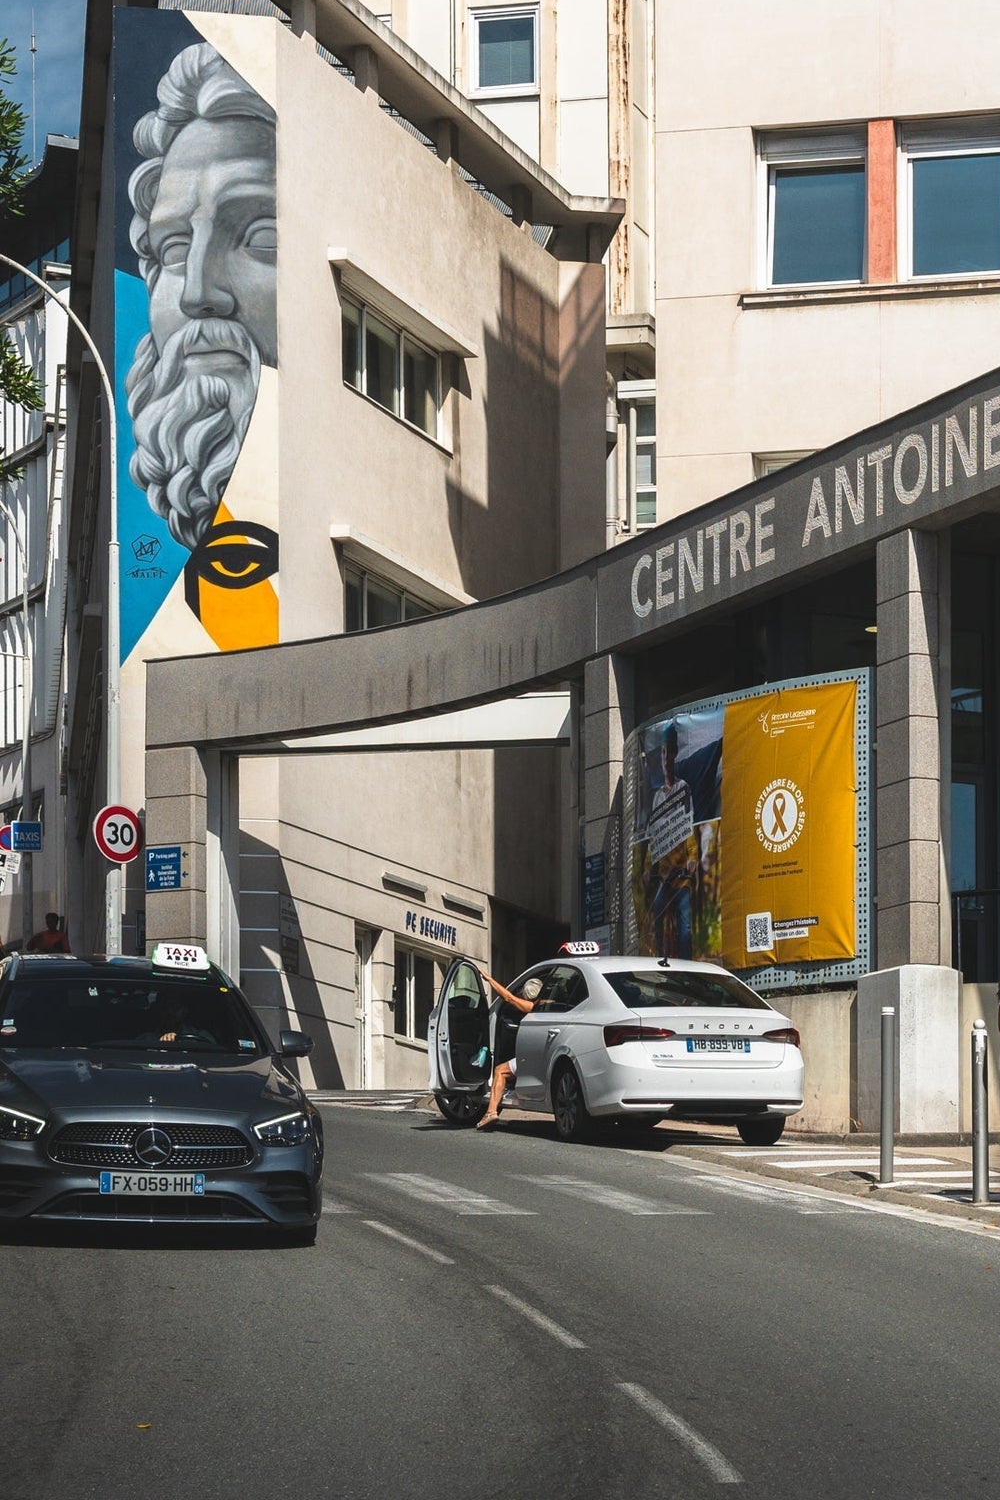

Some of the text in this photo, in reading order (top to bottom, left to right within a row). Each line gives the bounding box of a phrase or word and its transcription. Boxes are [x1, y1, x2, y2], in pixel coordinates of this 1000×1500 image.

[631, 497, 775, 618] CENTRE
[755, 778, 805, 820] SEPTEMBRE EN OR
[14, 831, 40, 842] TAXIS
[106, 822, 134, 846] 30
[755, 811, 806, 853] SEPTEMBRE EN OR
[774, 920, 794, 929] Changez
[164, 947, 197, 957] TAXI
[112, 1175, 203, 1193] FX-059-HH 06
